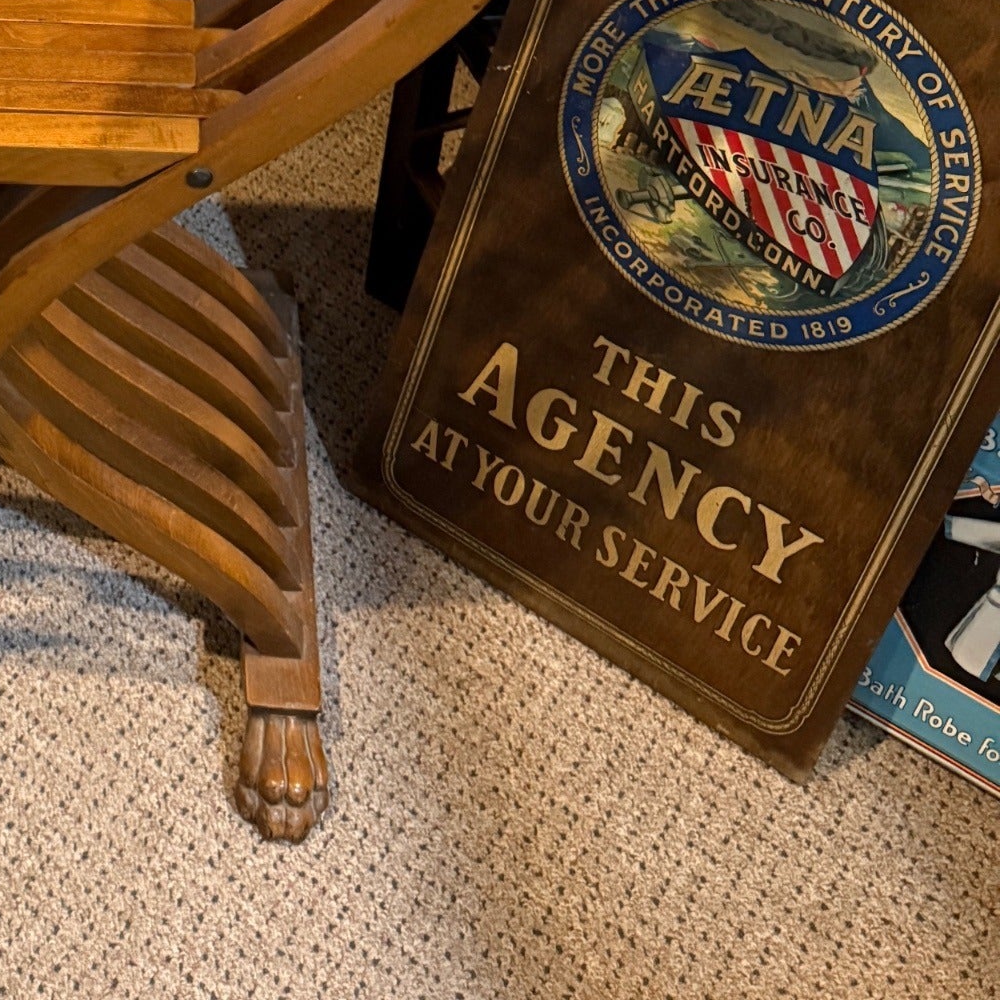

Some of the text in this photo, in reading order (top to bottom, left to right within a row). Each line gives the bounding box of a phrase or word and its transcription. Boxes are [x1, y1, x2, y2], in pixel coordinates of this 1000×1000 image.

[572, 20, 626, 97] MORE
[916, 72, 955, 113] OF
[633, 71, 826, 295] HARTFORD, CONN.
[696, 144, 871, 227] INSURANCE
[787, 208, 837, 250] CO.
[924, 127, 970, 264] SERVICE
[584, 196, 853, 341] INCORPORATED 1819
[592, 335, 742, 448] THIS
[457, 342, 825, 585] AGENCY
[410, 419, 802, 677] AT YOUR SERVICE
[858, 666, 1000, 765] Bath Robe fo
